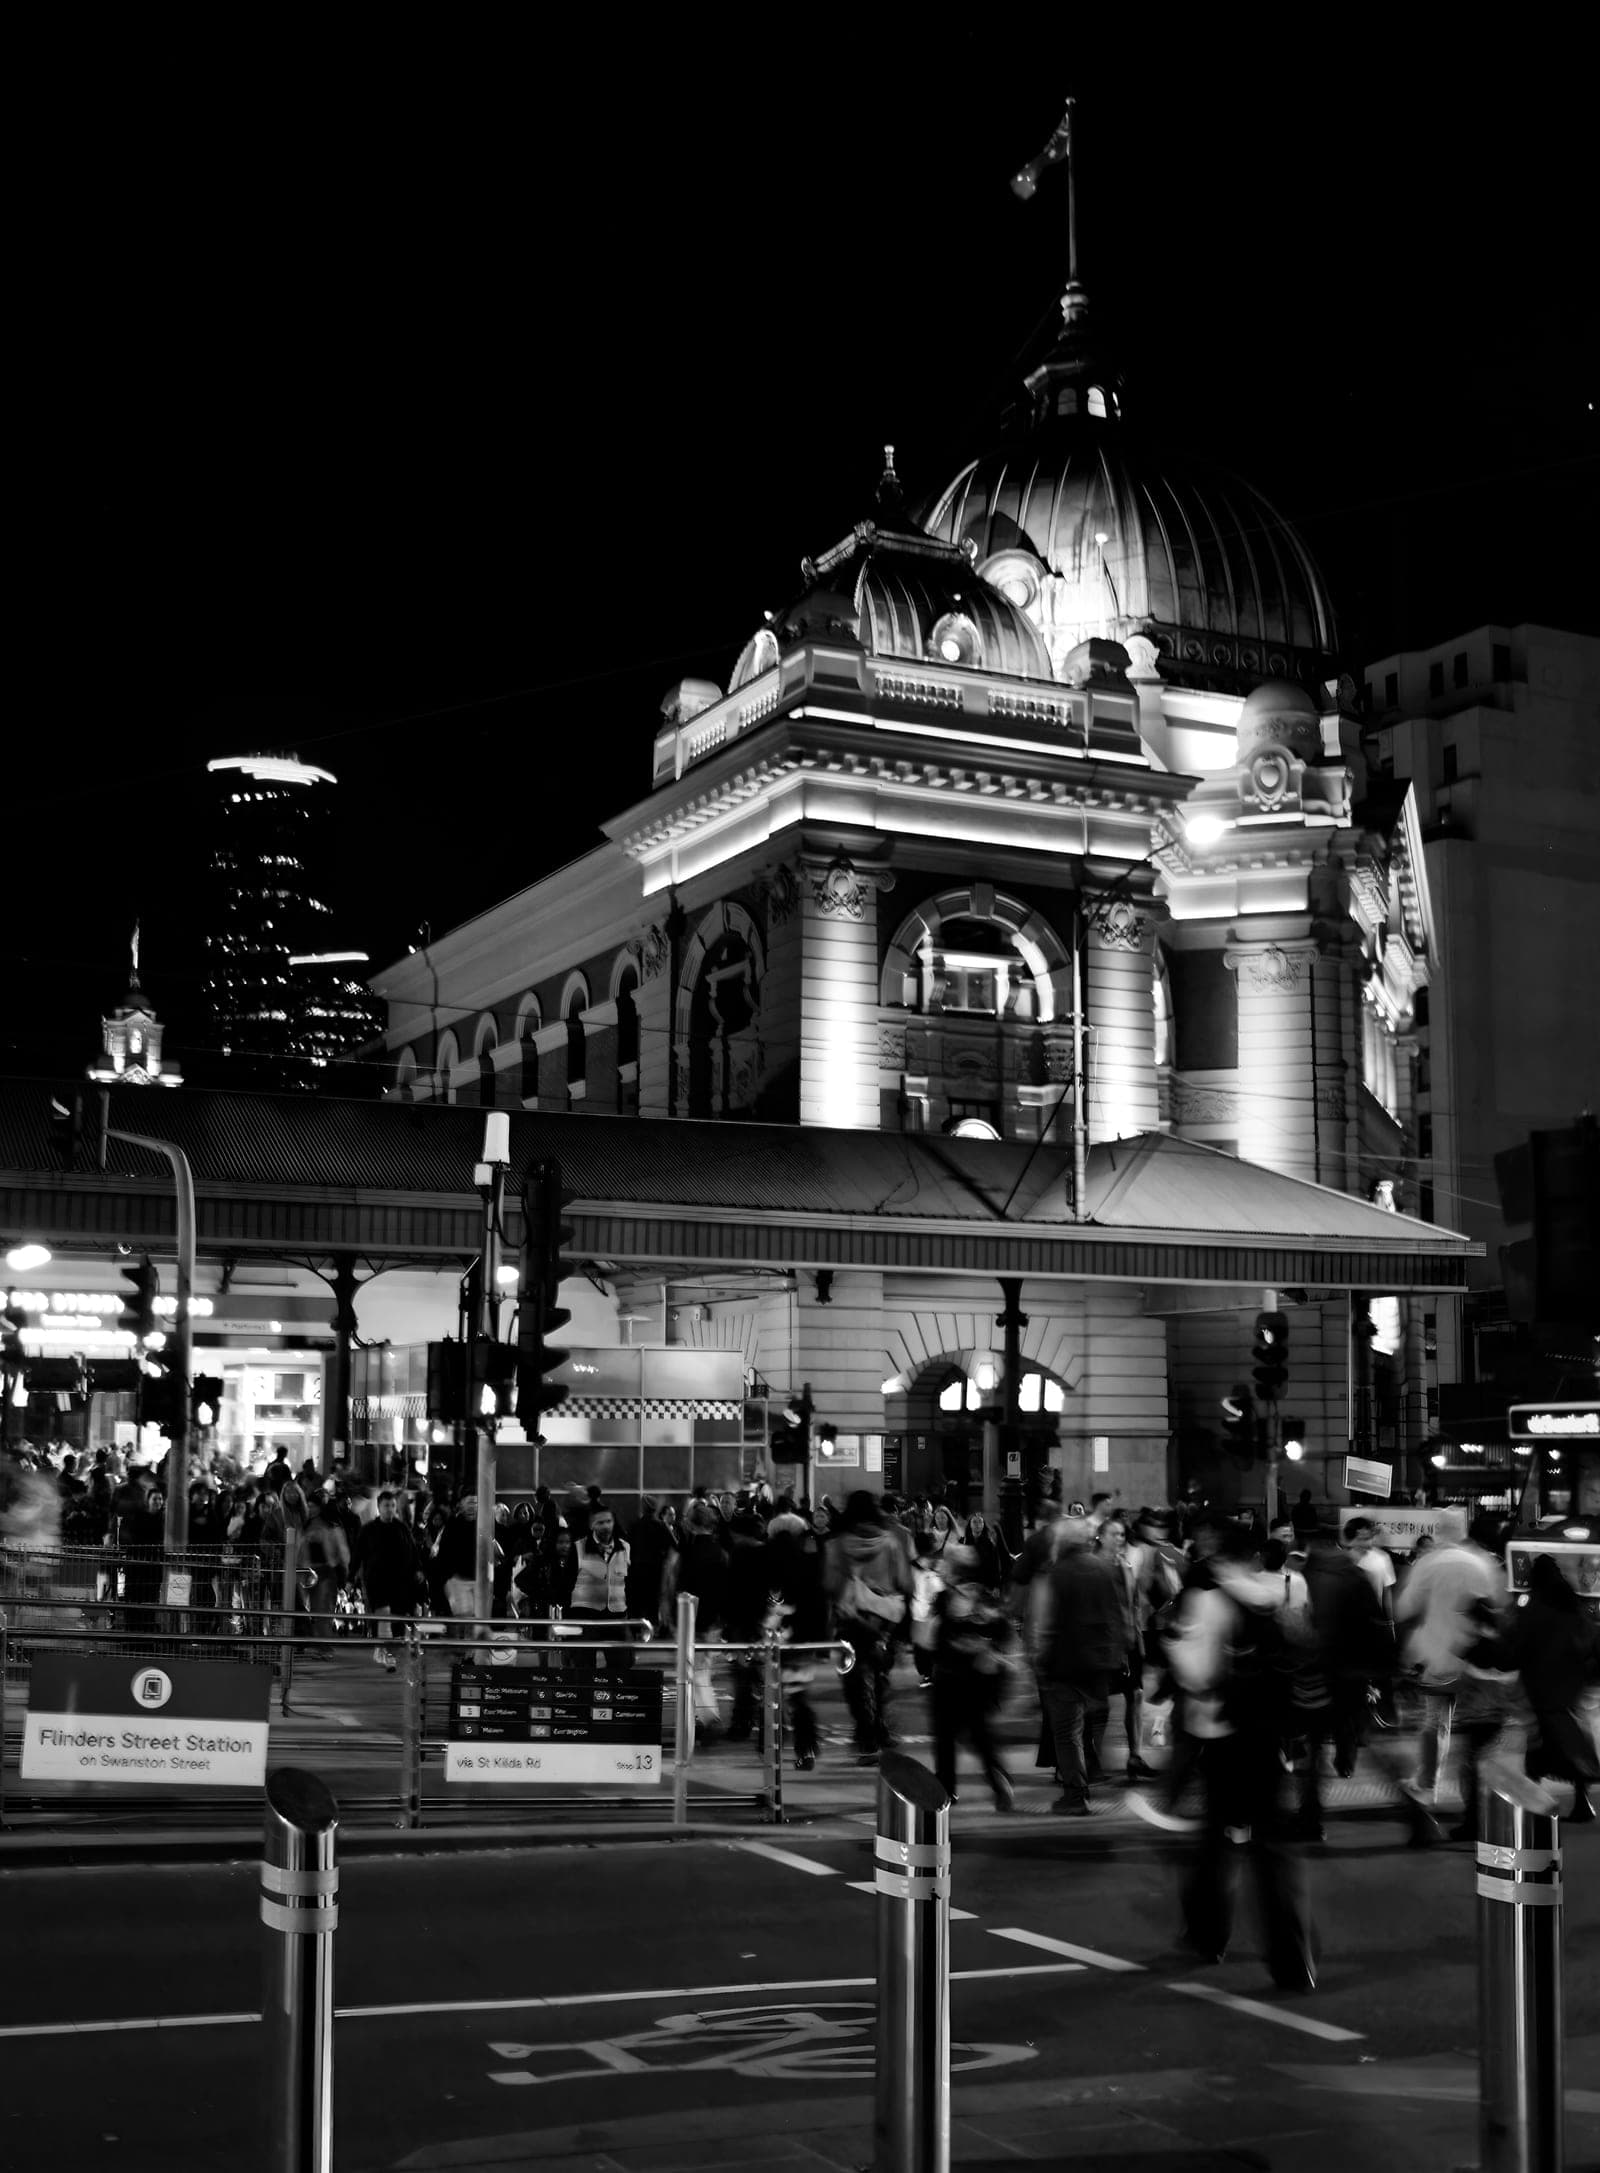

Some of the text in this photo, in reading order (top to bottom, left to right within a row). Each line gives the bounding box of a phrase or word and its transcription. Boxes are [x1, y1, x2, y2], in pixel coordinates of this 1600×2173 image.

[40, 1729, 253, 1753] Flinders Street Station
[80, 1754, 211, 1771] on Swanston Street
[457, 1757, 541, 1769] via St Kilda Rd
[635, 1754, 653, 1770] 13
